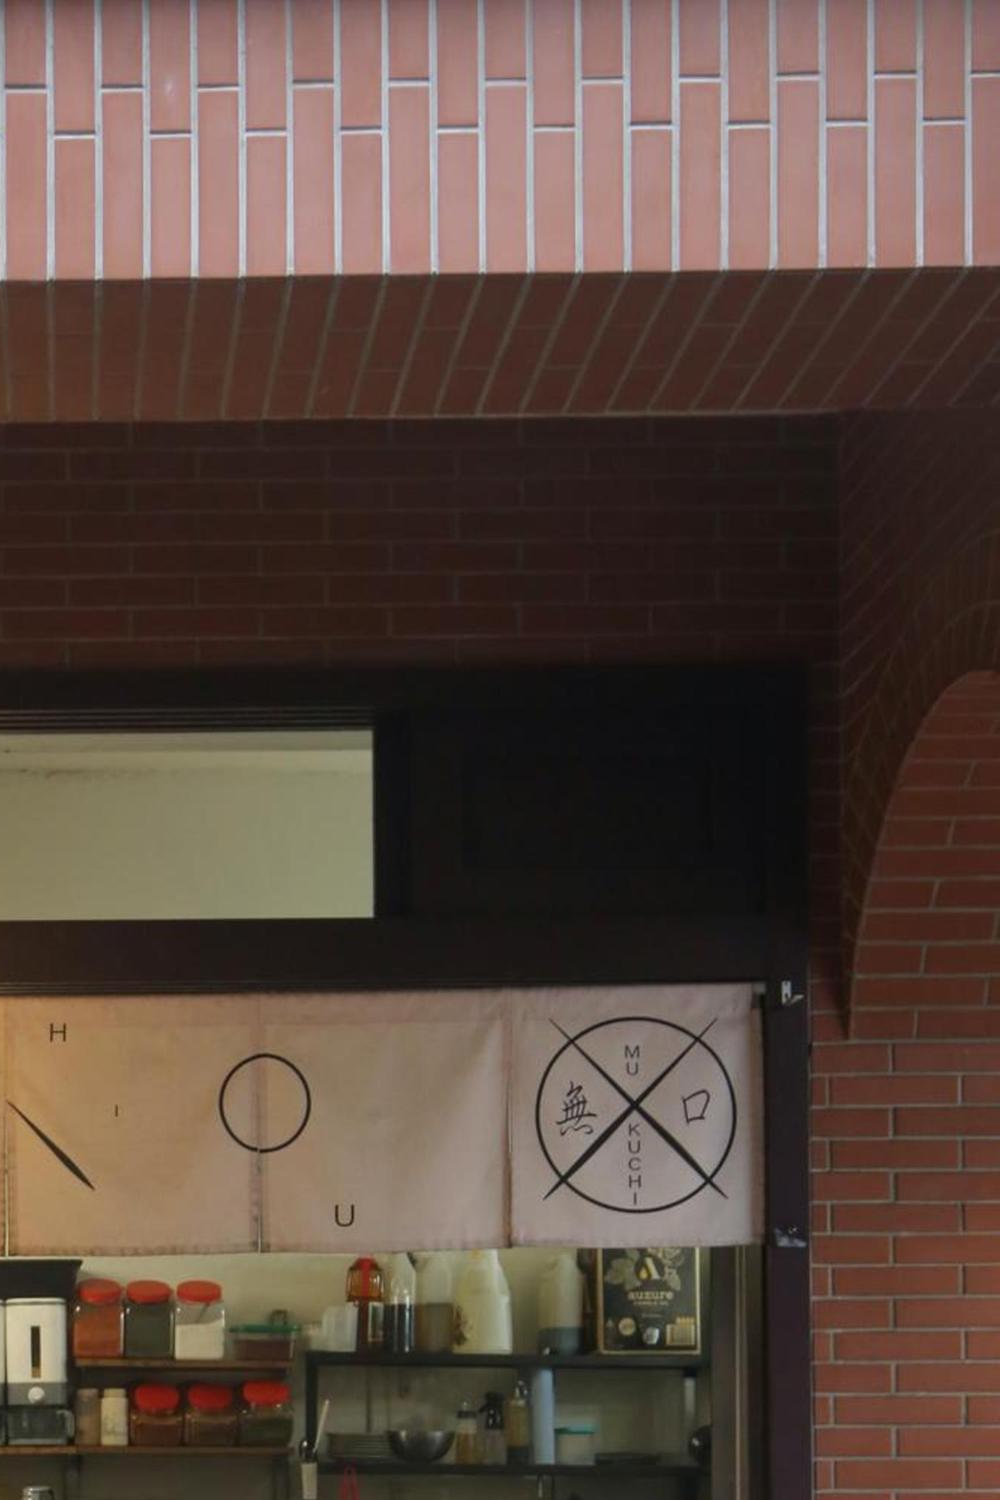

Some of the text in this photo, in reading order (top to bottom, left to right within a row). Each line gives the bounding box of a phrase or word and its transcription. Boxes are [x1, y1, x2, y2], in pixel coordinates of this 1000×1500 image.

[49, 1022, 67, 1043] H
[624, 1044, 641, 1076] MU
[555, 1080, 600, 1139] 無
[627, 1123, 642, 1206] KUCHI
[334, 1203, 355, 1228] U
